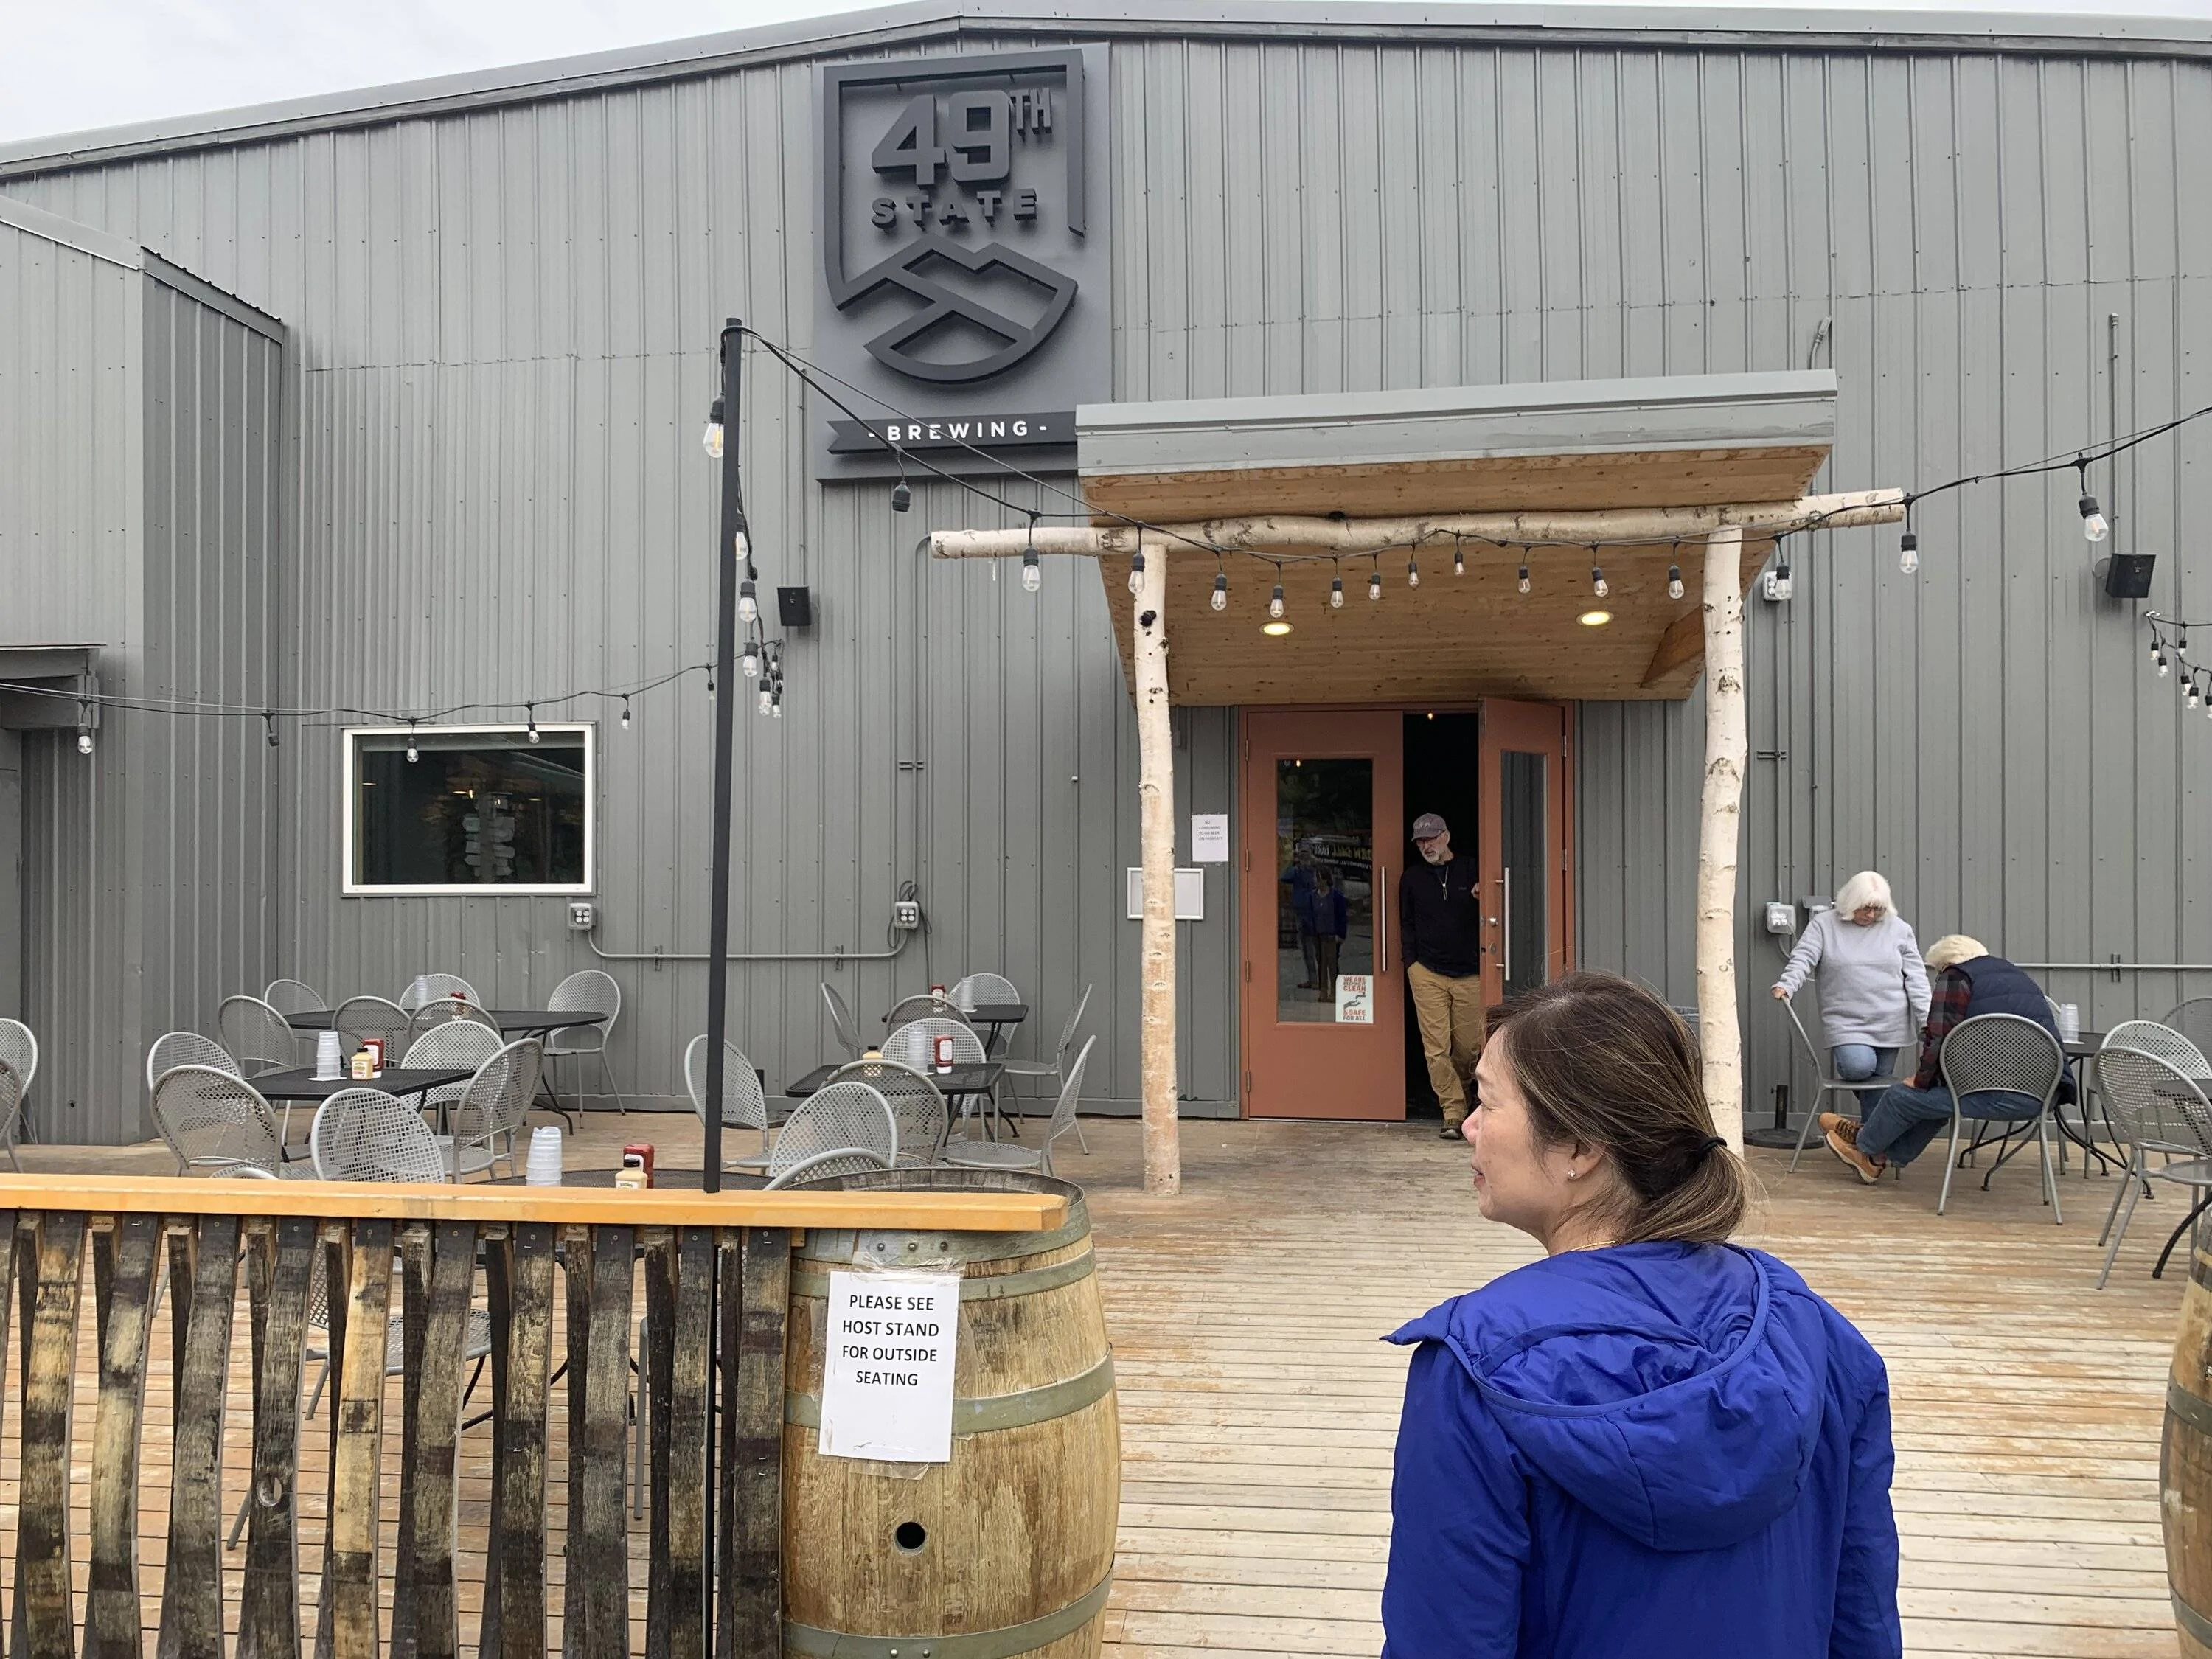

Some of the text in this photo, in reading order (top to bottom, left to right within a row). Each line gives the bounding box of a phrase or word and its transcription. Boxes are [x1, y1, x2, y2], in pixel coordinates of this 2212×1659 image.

[872, 188, 1037, 229] STATE
[887, 420, 1028, 441] BREWING
[849, 1295, 934, 1310] PLEASE SEE
[843, 1320, 939, 1336] HOST STAND
[843, 1346, 937, 1362] FOR OUTSIDE
[855, 1371, 918, 1386] SEATING
